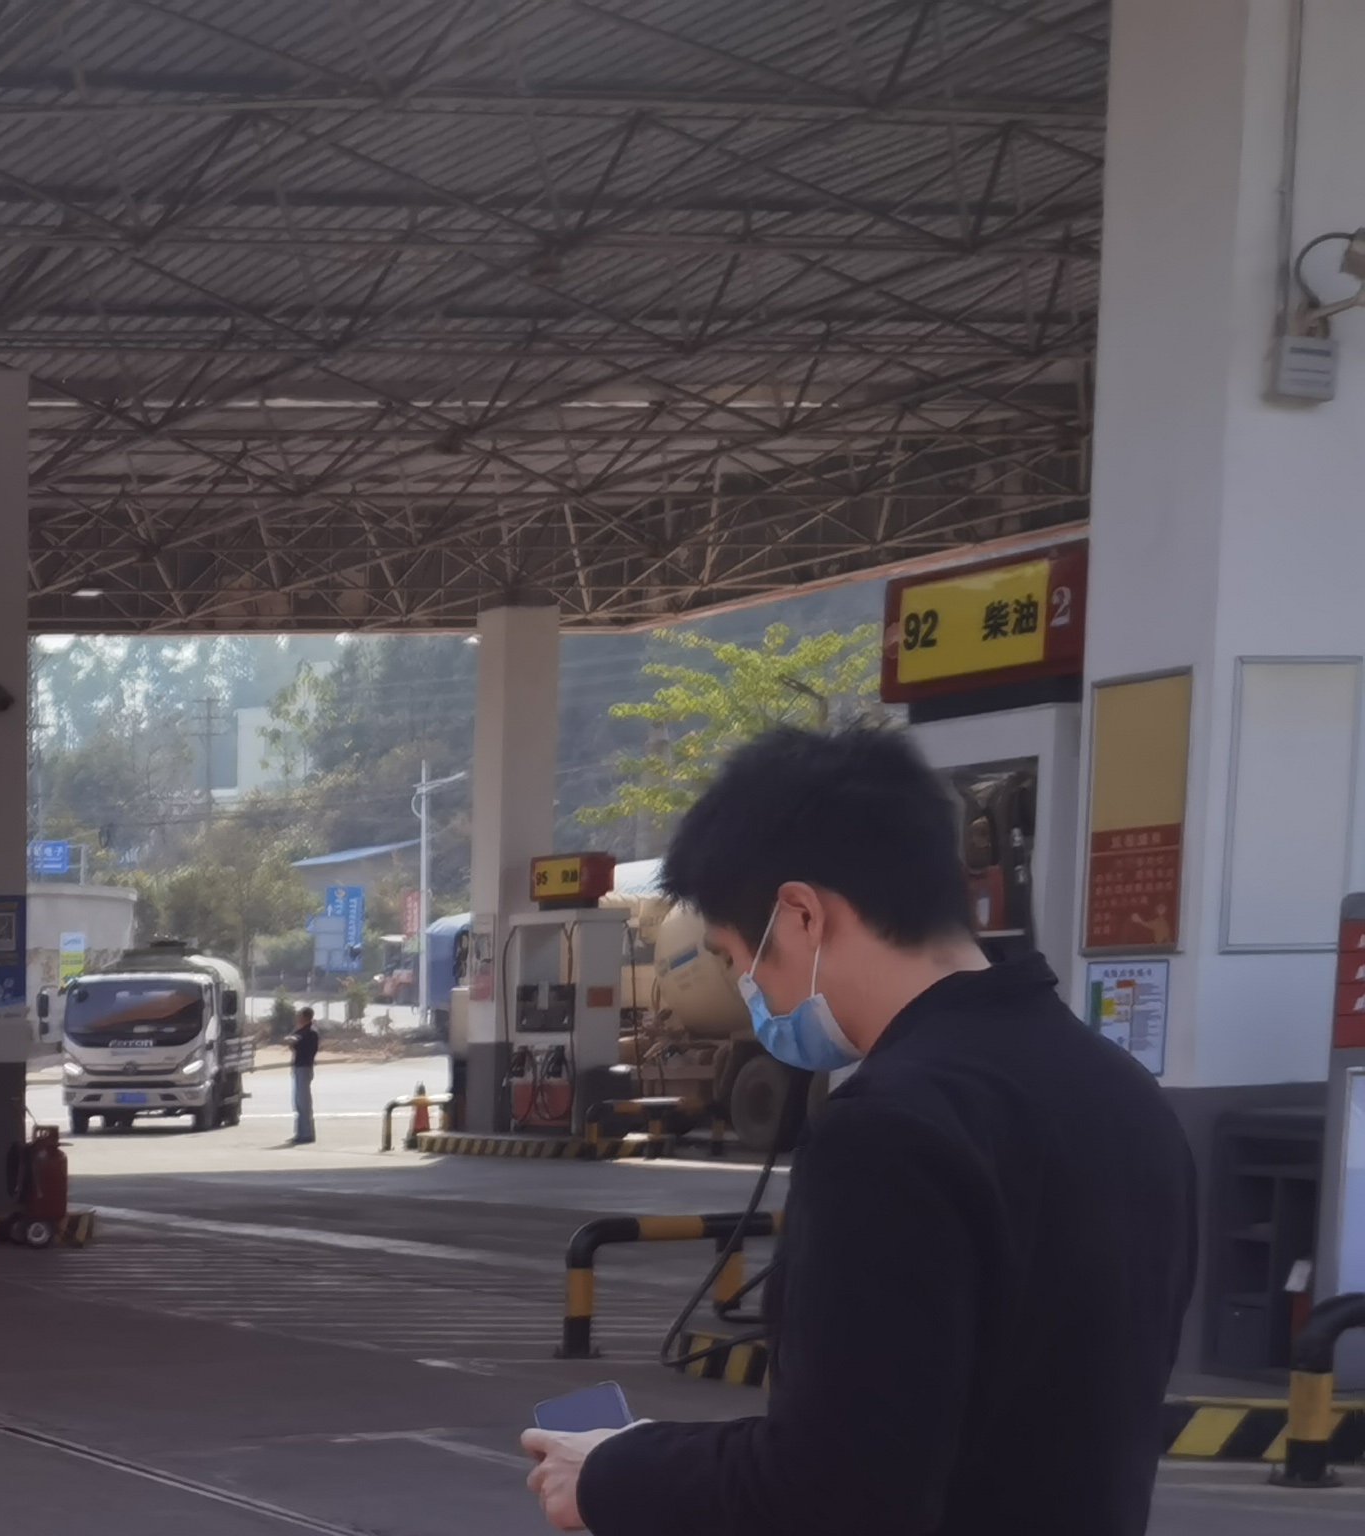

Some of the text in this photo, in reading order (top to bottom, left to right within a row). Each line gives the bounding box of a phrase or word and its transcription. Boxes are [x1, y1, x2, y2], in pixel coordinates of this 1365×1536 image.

[903, 586, 1073, 650] 92 柴油 2
